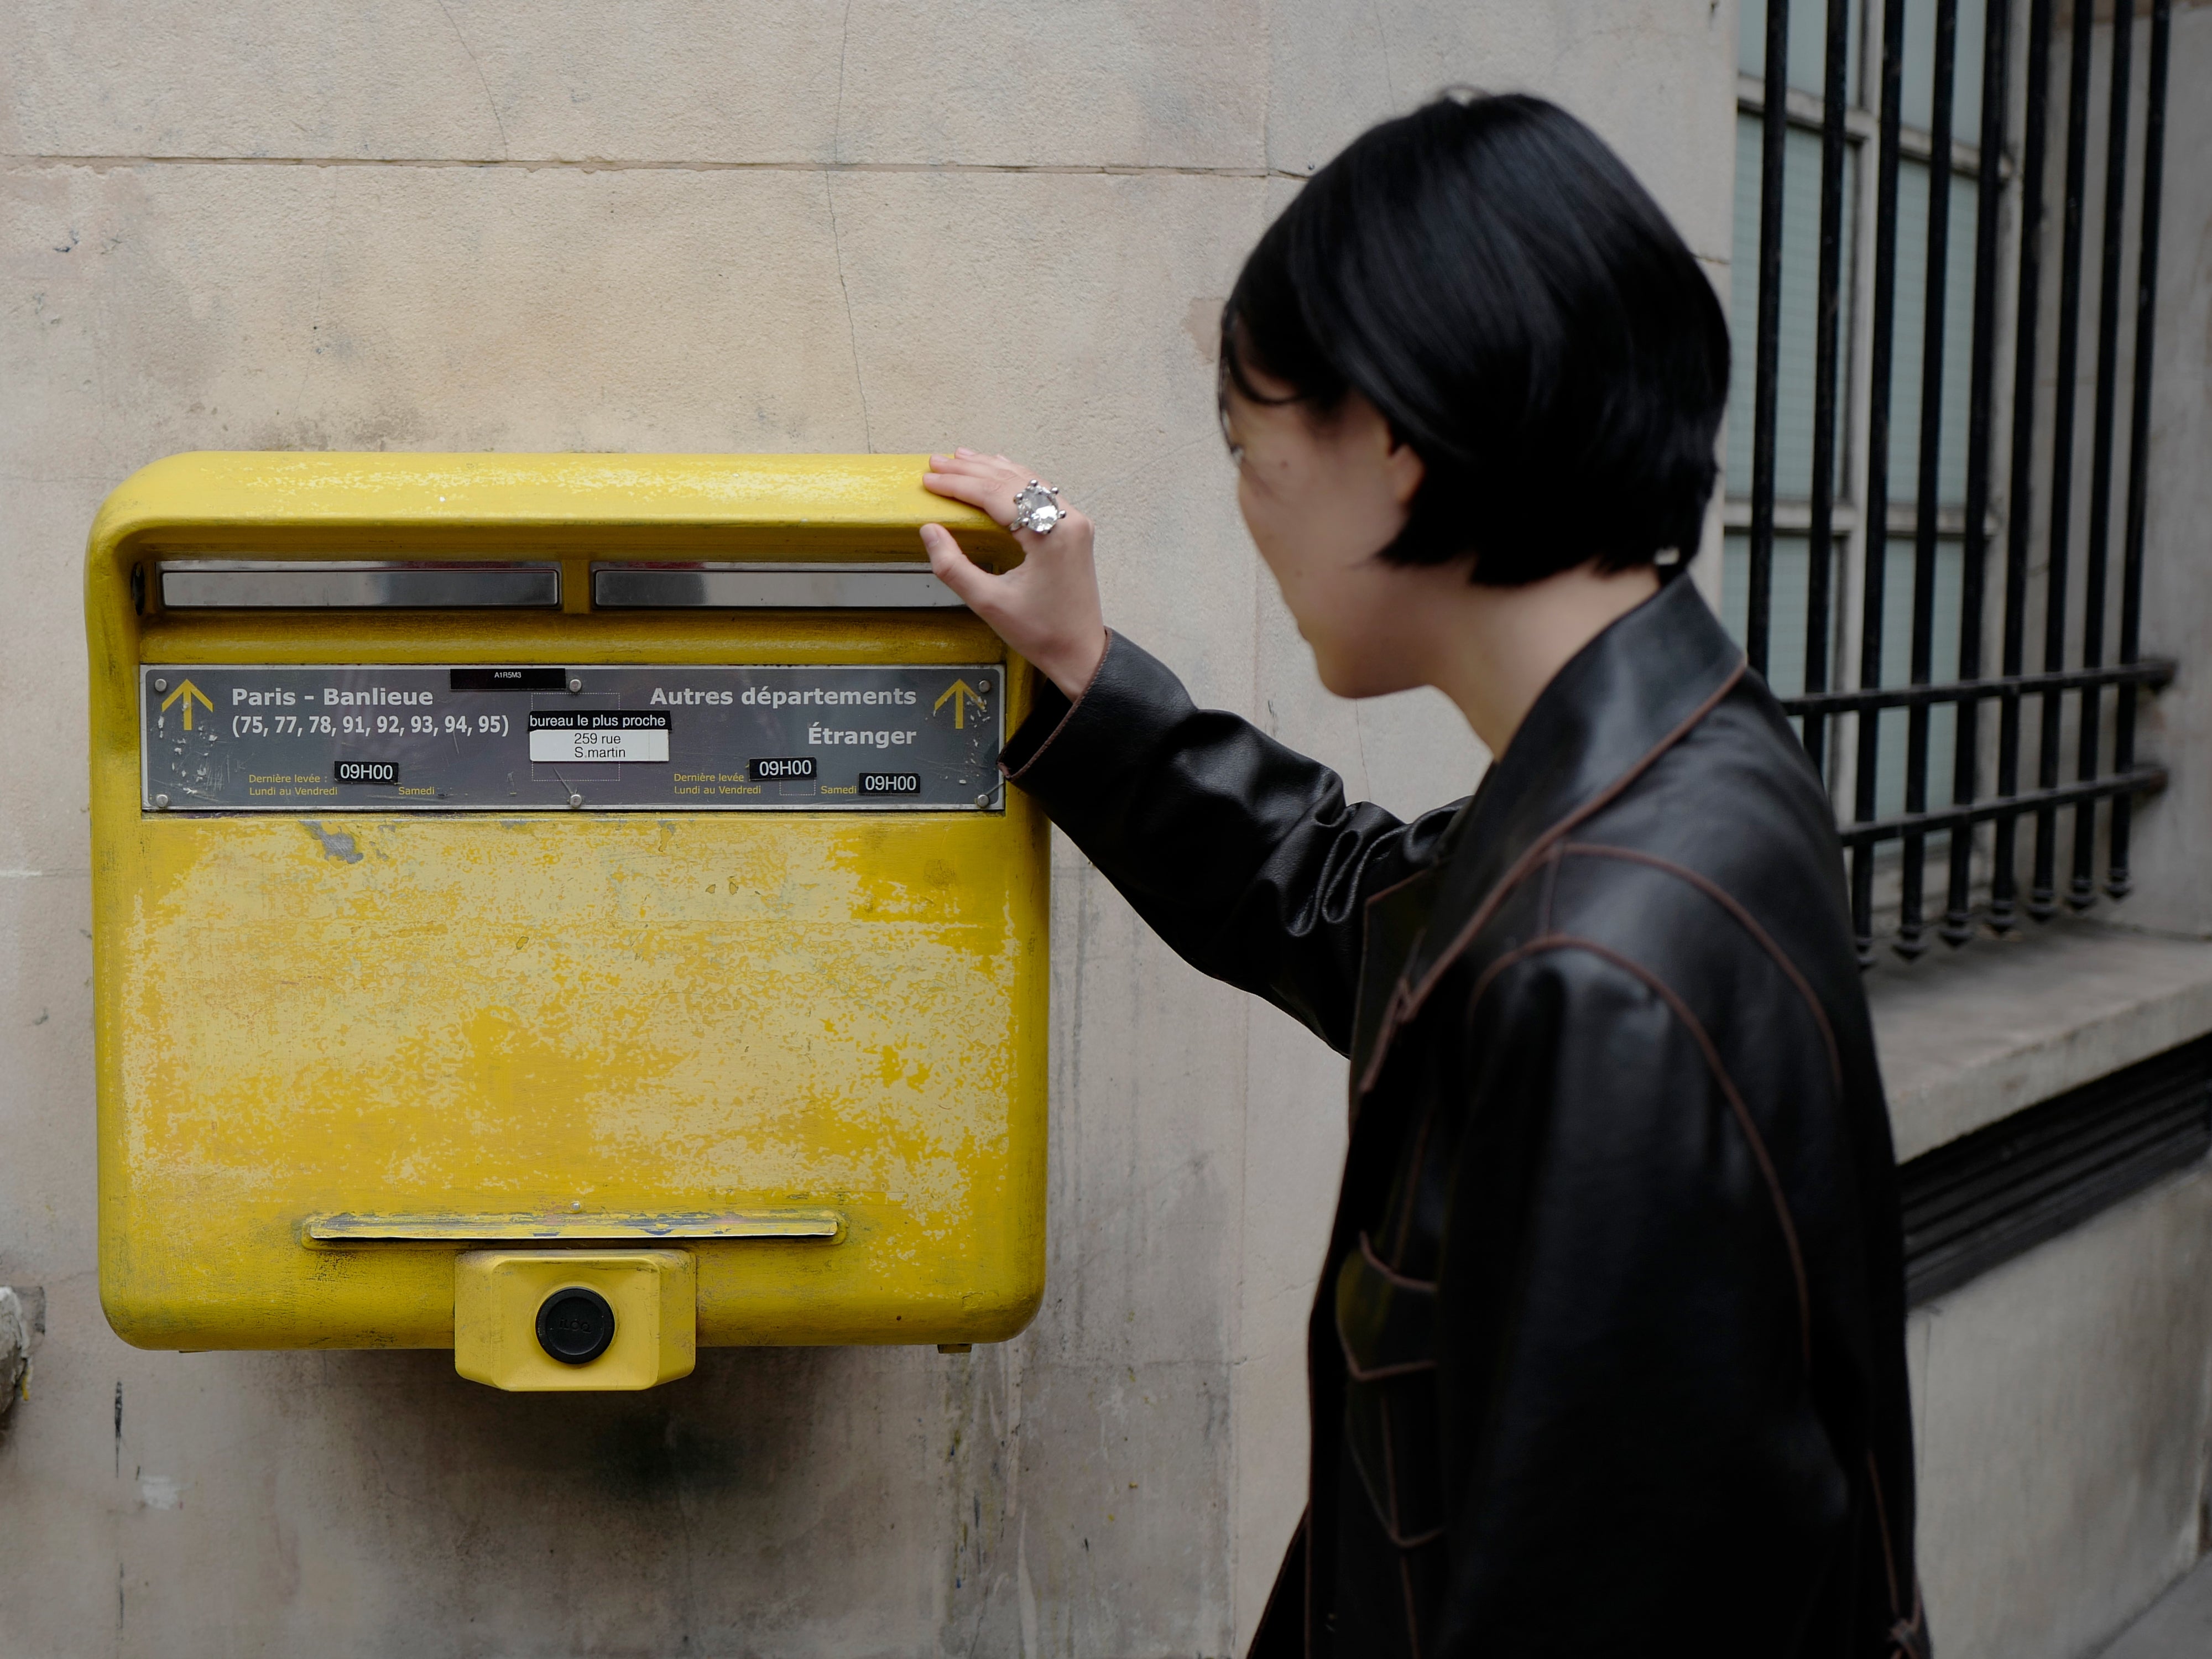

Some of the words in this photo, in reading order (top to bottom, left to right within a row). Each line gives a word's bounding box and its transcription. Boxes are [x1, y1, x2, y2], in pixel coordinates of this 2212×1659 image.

[232, 688, 295, 706] Paris
[324, 687, 434, 706] Banlieue
[650, 687, 733, 705] Autres
[741, 686, 916, 709] départements
[232, 716, 268, 737] (75,
[274, 716, 302, 737] 77,
[309, 716, 337, 737] 78,
[343, 716, 371, 737] 91,
[377, 716, 405, 737] 92,
[411, 716, 439, 737] 93,
[445, 716, 472, 737] 94,
[479, 715, 509, 737] 95)
[530, 715, 573, 727] bureau
[577, 715, 588, 726] le
[593, 715, 618, 727] plus
[623, 715, 666, 727] proche
[574, 733, 597, 744] 259
[602, 736, 621, 744] rue
[808, 722, 916, 749] Étranger
[340, 764, 393, 780] 09H00
[759, 760, 812, 775] 09H00
[249, 774, 291, 783] Dernière
[294, 774, 320, 783] levée
[674, 773, 715, 782] Dernière
[719, 773, 744, 782] levée
[865, 776, 917, 791] 09H00
[249, 787, 275, 795] Lundi
[295, 787, 338, 795] Vendredi
[398, 786, 435, 795] Samedi
[675, 786, 700, 794] Lundi
[719, 786, 761, 794] Vendredi
[821, 786, 857, 794] Samedi
